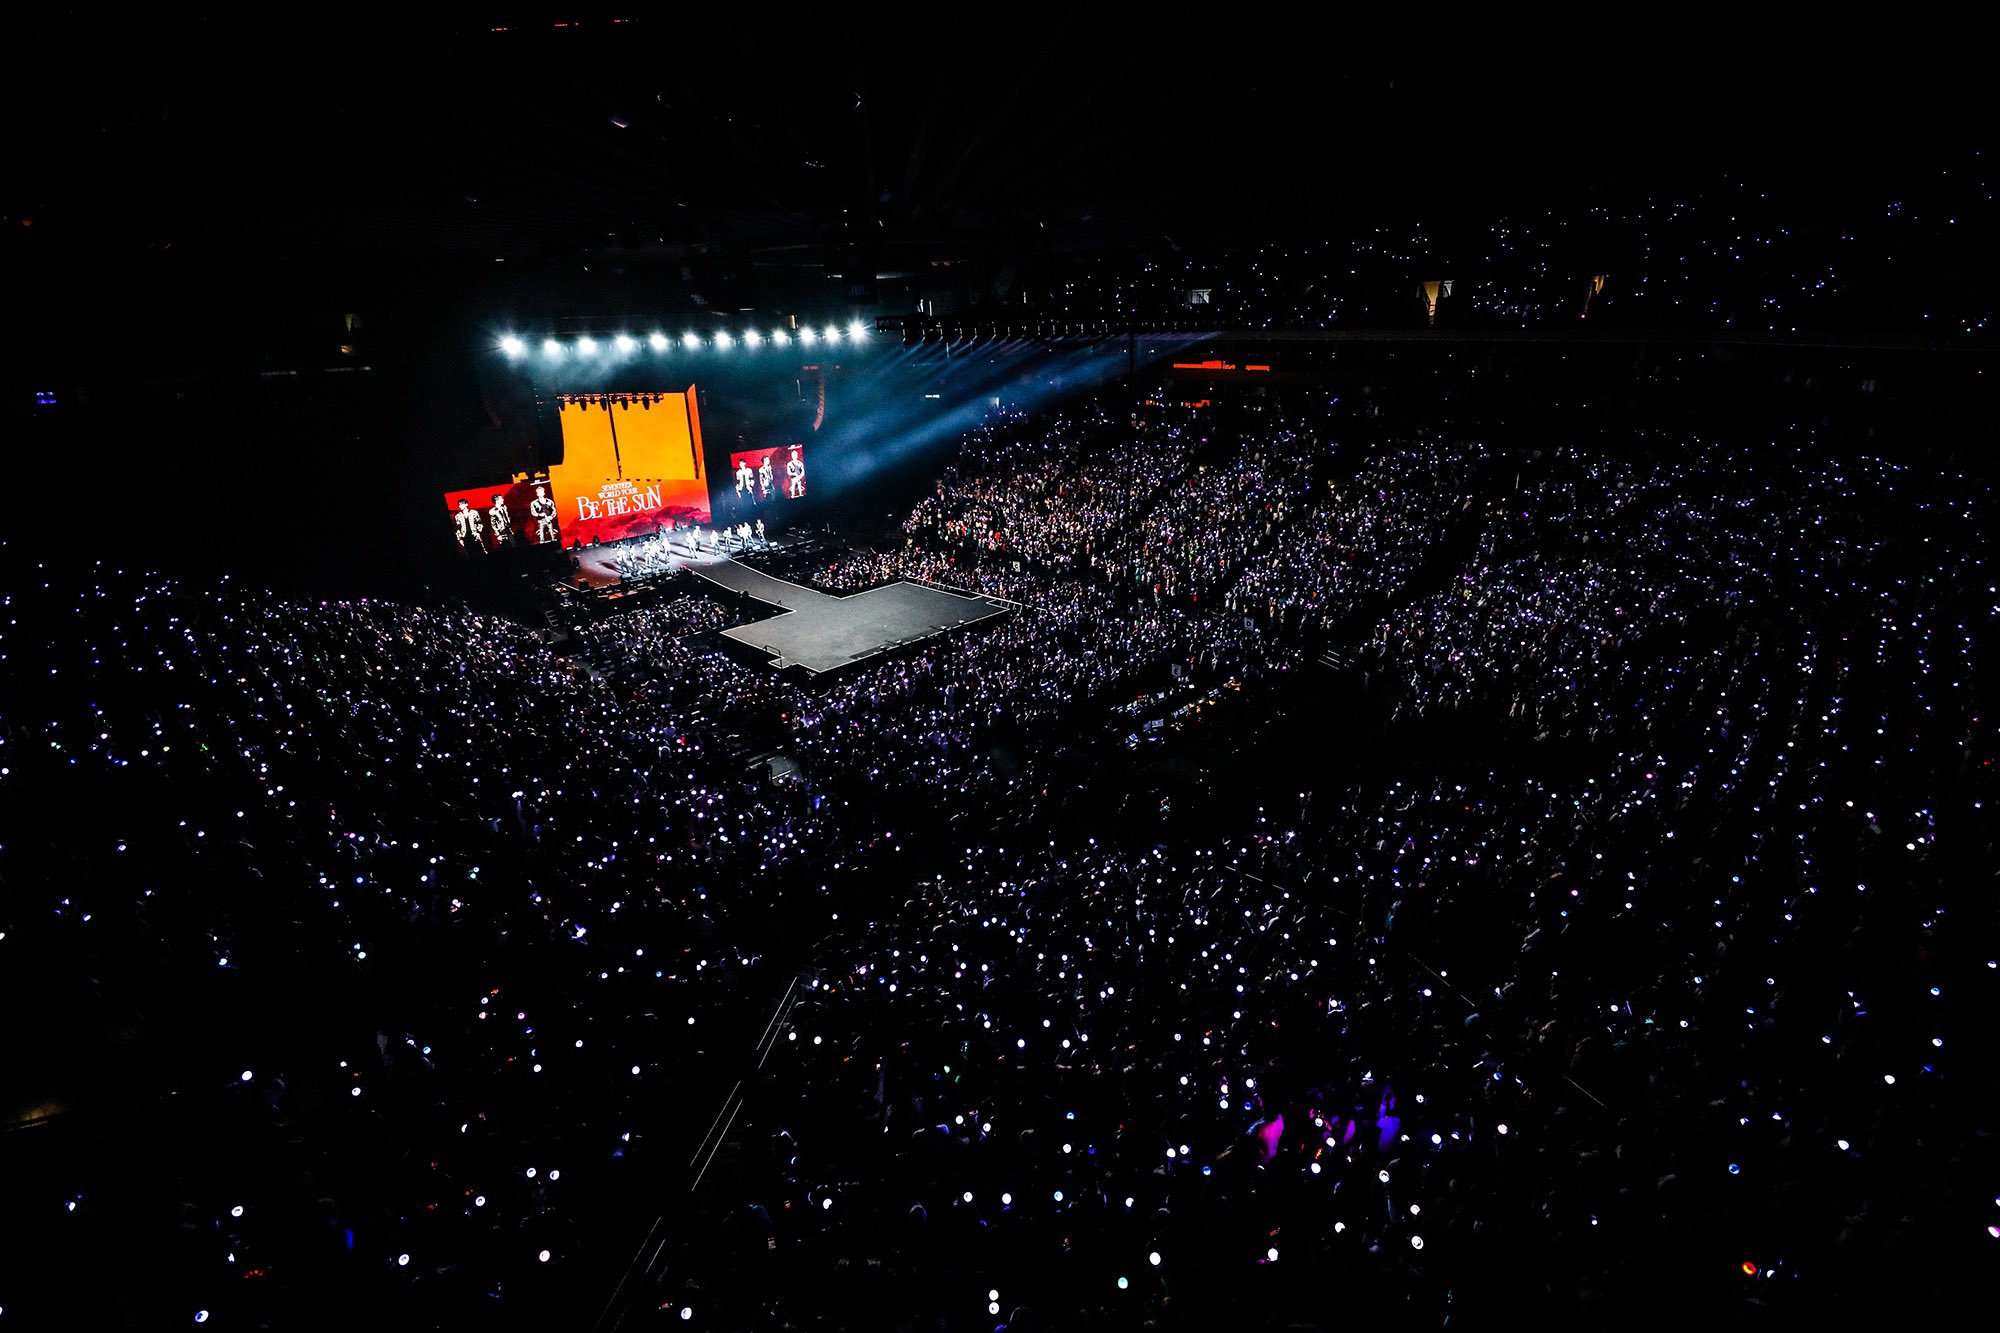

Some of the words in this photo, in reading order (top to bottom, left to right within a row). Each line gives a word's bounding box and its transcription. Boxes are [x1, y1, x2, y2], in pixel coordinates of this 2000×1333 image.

[601, 481, 632, 491] SEVENTEEN
[598, 490, 620, 499] WORLD
[621, 487, 639, 495] TOUR
[576, 496, 602, 521] BE
[602, 496, 631, 516] THE
[631, 484, 662, 512] SUN
